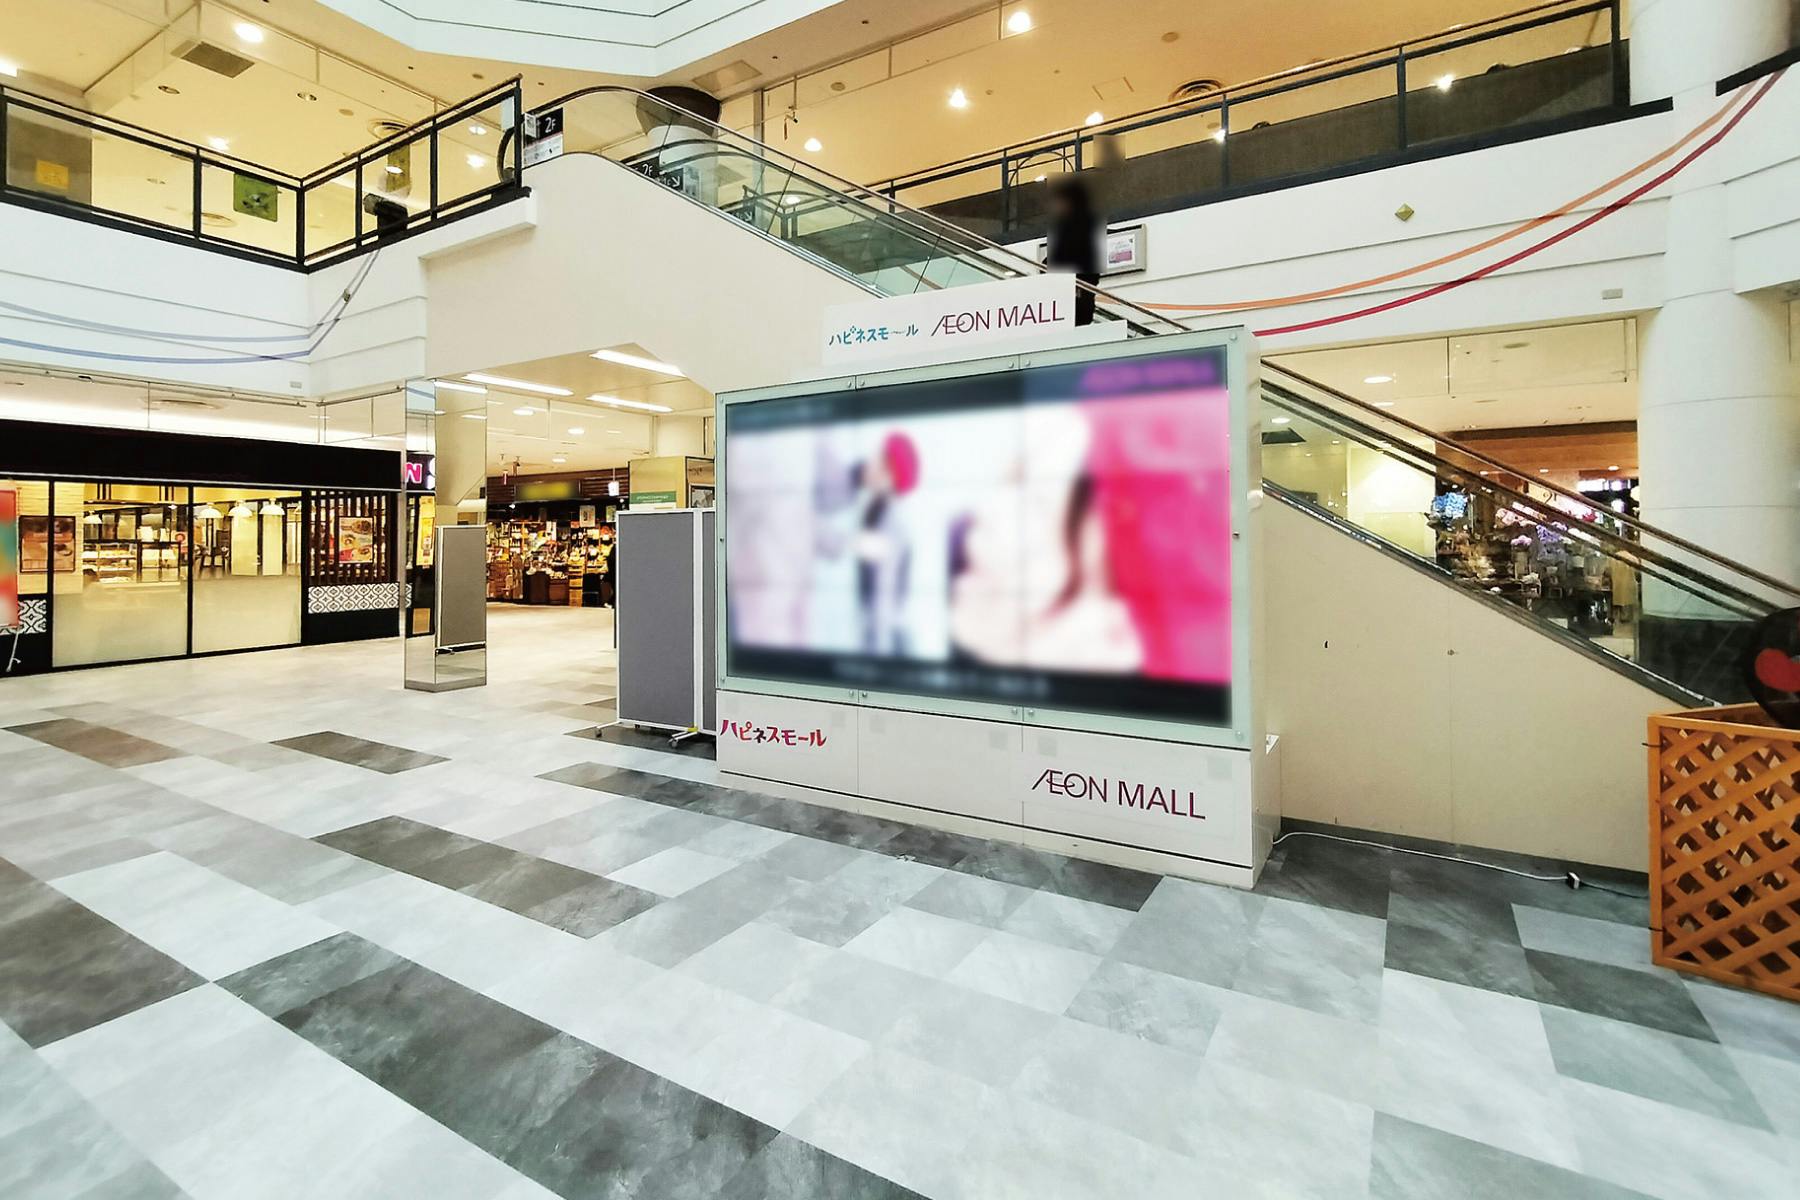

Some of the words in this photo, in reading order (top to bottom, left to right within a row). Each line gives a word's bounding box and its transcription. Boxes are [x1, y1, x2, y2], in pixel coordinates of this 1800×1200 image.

[545, 116, 556, 133] 2F
[998, 300, 1065, 329] MALL
[720, 719, 828, 747] ハピネスモール
[1118, 780, 1206, 820] MALL
